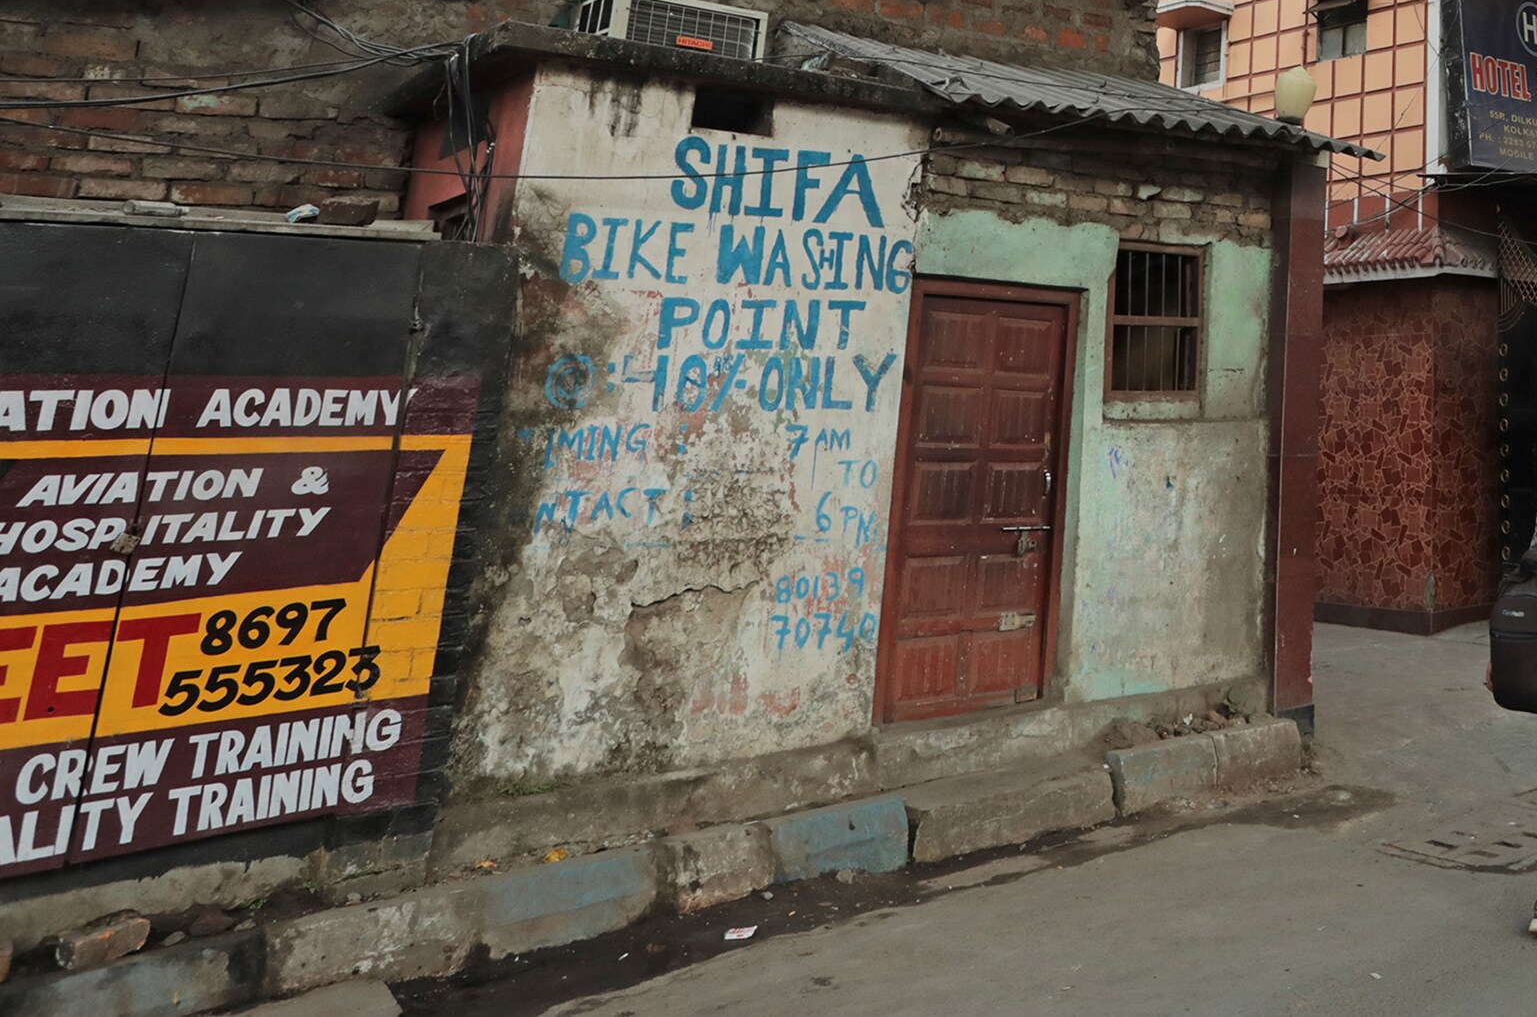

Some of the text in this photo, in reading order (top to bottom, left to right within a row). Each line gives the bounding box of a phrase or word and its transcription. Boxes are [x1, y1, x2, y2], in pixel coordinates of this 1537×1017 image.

[1470, 52, 1532, 102] HOTEL
[1499, 147, 1534, 160] MOBILE
[671, 136, 884, 228] SHIFA
[560, 212, 694, 283] BIKE
[658, 299, 867, 351] POINT
[196, 387, 418, 428] ACADEMY
[759, 353, 898, 413] ONLY
[520, 423, 651, 470] IMING
[813, 427, 852, 452] AM
[16, 465, 330, 508] AVIATION &
[837, 459, 878, 489] TO
[0, 507, 331, 556] HOSPITALITY
[533, 486, 668, 536] NTACT
[815, 491, 833, 533] 6
[0, 551, 242, 603] ACADEMY
[200, 597, 347, 656] 8697
[158, 646, 382, 717] 555323
[15, 709, 402, 806] CREW TRAINING
[168, 759, 374, 837] TRAINING
